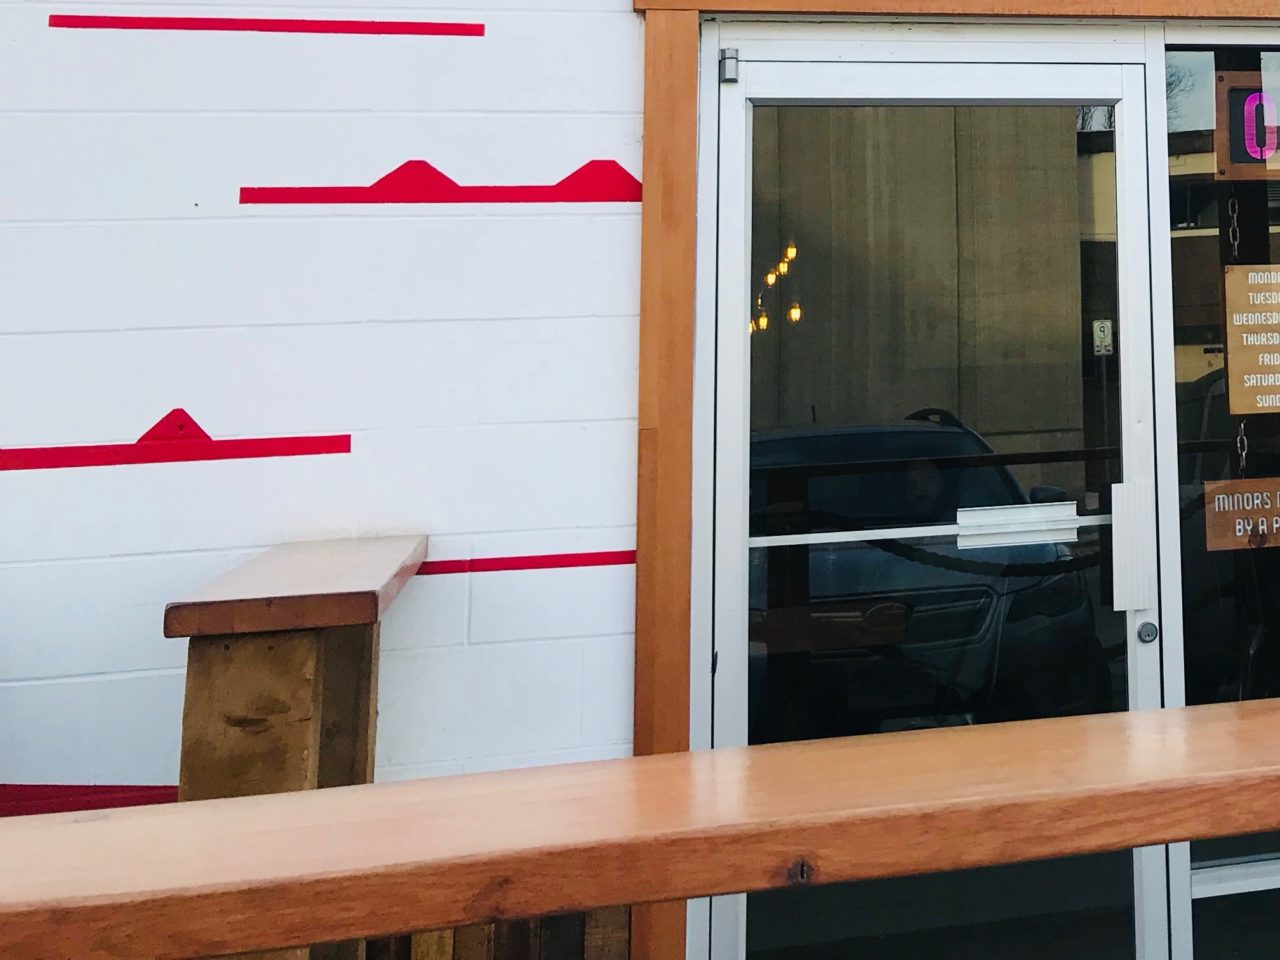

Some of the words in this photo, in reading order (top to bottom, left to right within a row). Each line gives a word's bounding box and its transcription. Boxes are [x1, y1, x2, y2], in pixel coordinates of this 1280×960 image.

[1214, 491, 1273, 512] MINORS
[1235, 518, 1254, 537] BY
[1258, 516, 1269, 535] A
